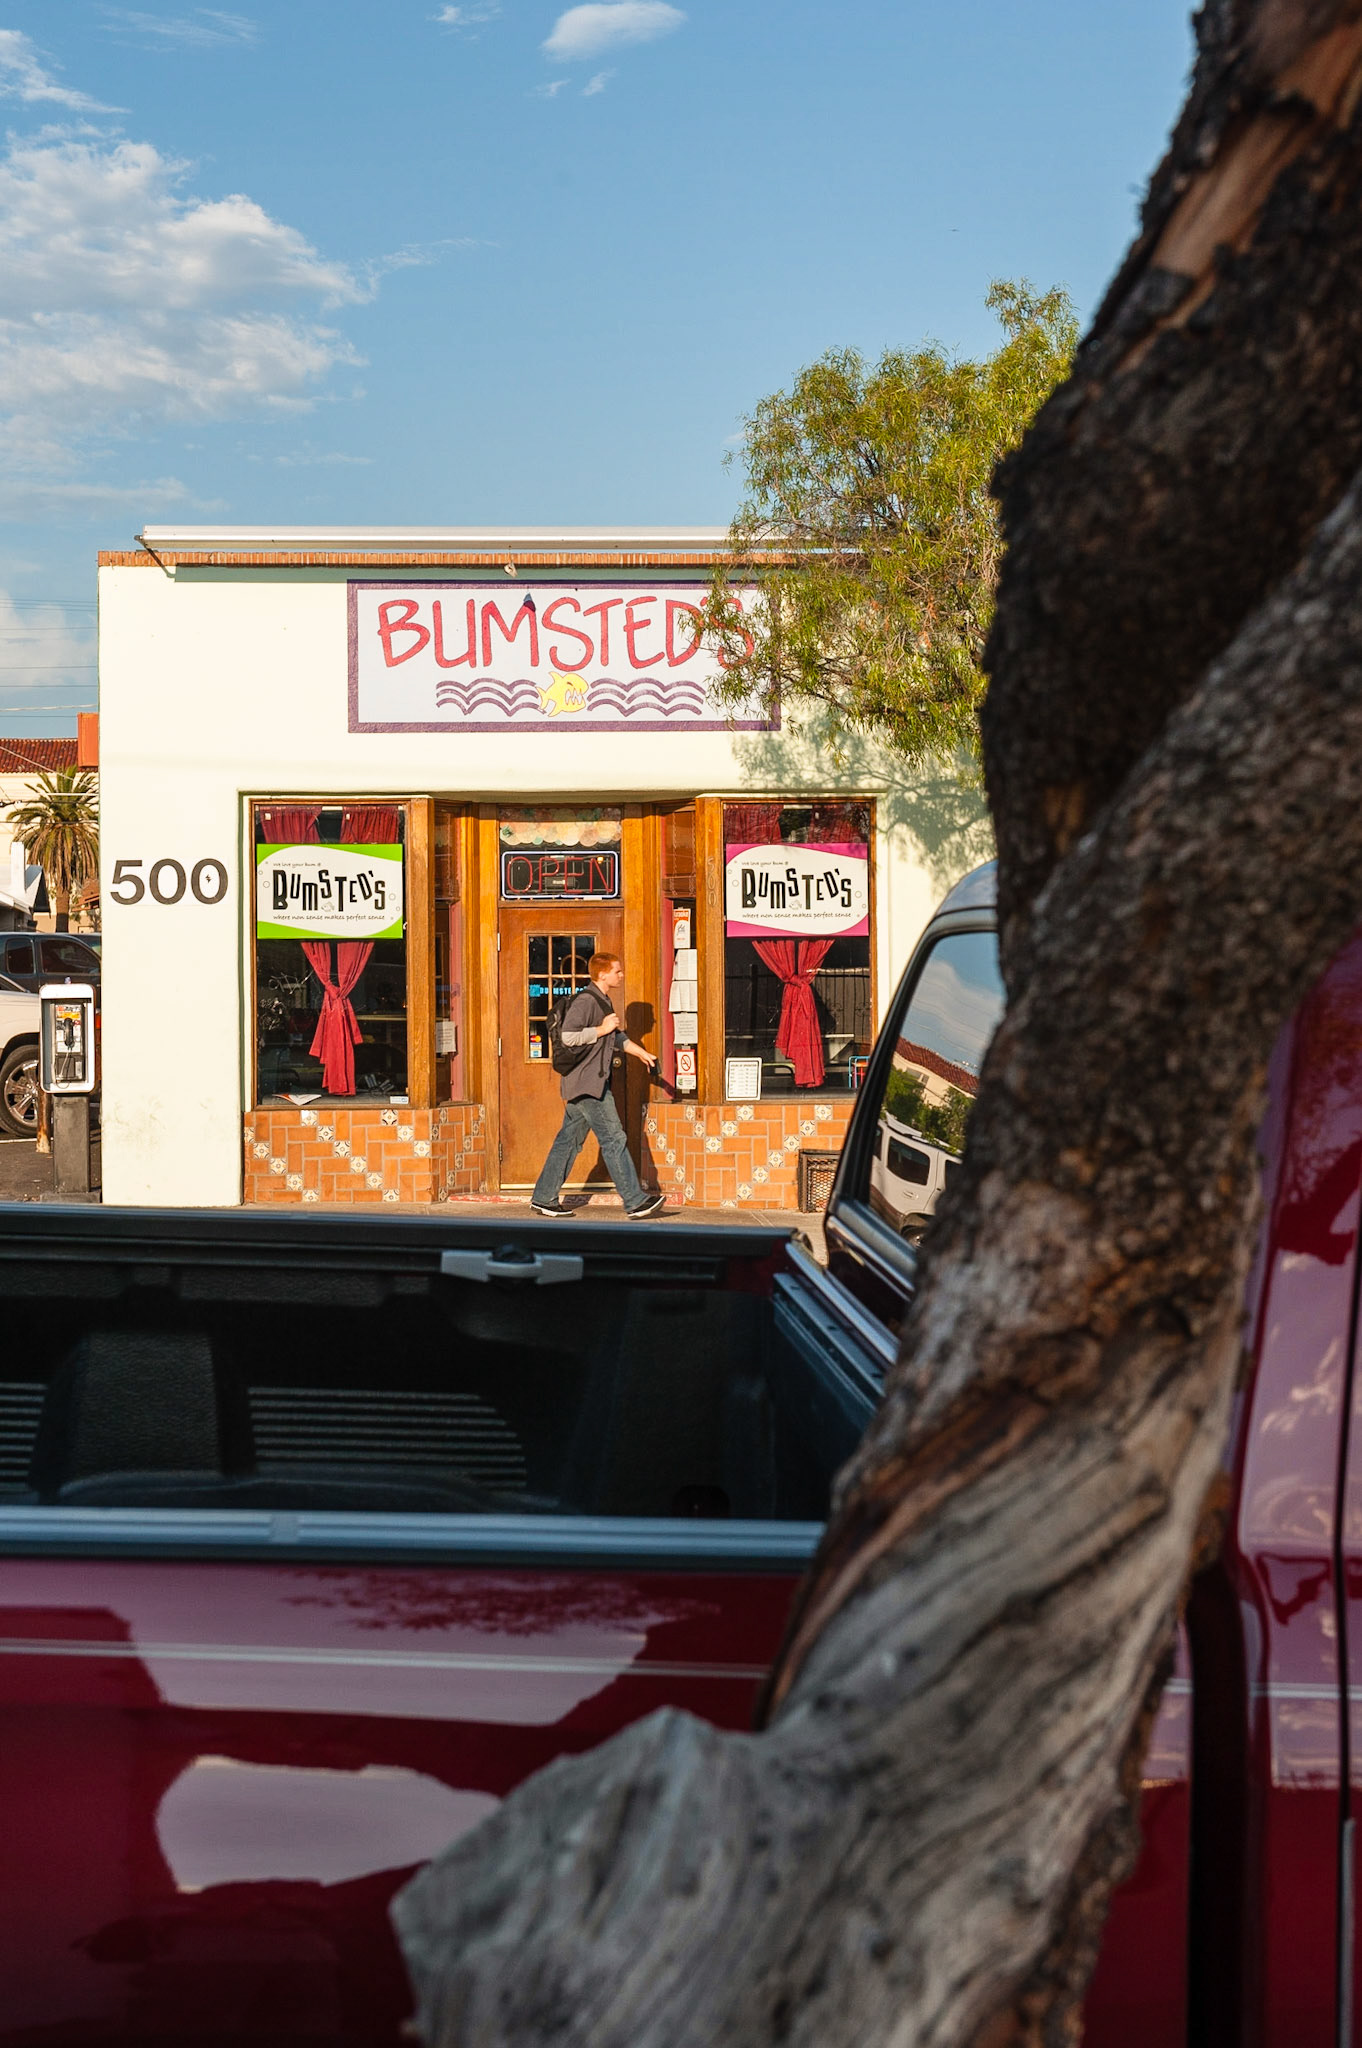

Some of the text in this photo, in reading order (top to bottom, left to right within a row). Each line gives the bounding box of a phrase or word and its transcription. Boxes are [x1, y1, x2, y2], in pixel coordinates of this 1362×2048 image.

[377, 595, 755, 672] BUMSTED'S
[109, 858, 229, 906] 500
[506, 856, 614, 893] OPEN
[346, 914, 367, 922] perfect
[813, 911, 834, 919] perfect
